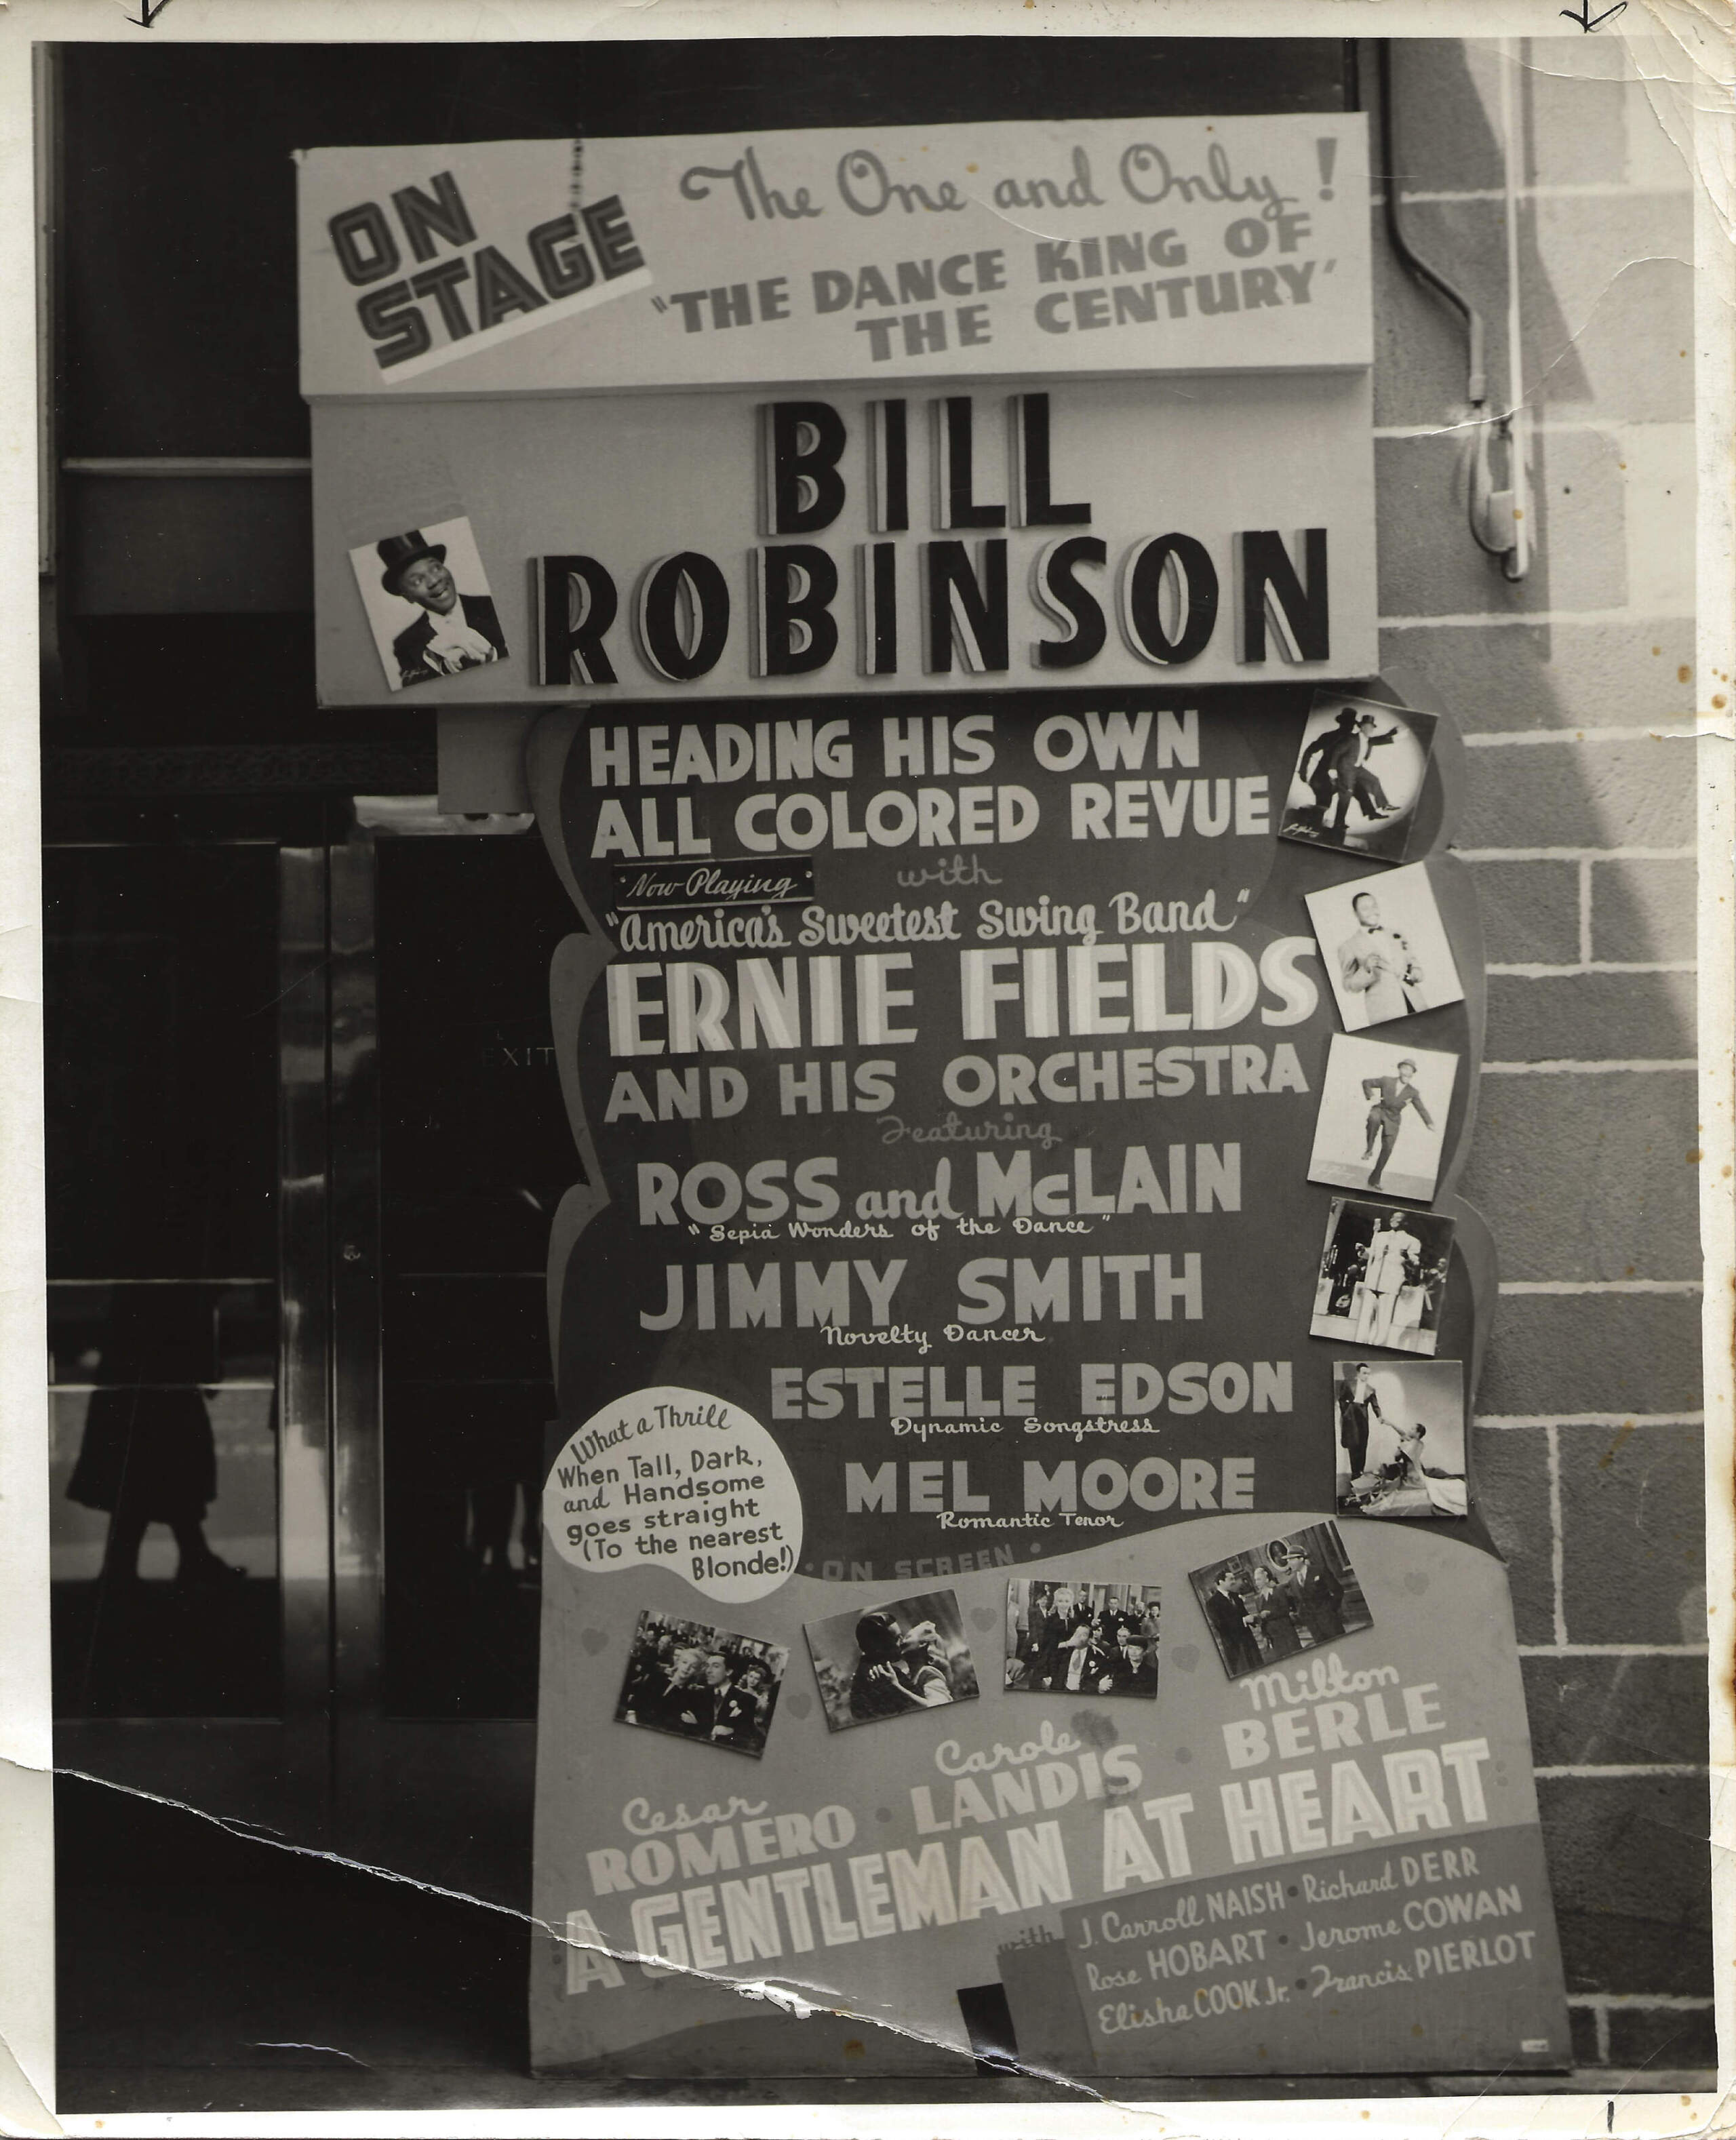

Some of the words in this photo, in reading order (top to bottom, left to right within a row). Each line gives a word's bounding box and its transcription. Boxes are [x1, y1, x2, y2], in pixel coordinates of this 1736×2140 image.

[679, 146, 824, 221] The
[837, 149, 967, 216] One
[993, 145, 1105, 207] and
[328, 170, 478, 286] ON
[356, 195, 645, 368] STAGE
[812, 250, 1006, 314] DANCE
[1035, 229, 1187, 283] KING
[1224, 213, 1311, 258] OF
[855, 304, 991, 362] THE
[758, 393, 1092, 535] BILL
[528, 528, 1330, 686] ROBINSON
[589, 719, 853, 787] HEADING
[883, 715, 995, 777] HIS
[1033, 710, 1200, 771] OWN
[590, 797, 711, 858] ALL
[734, 785, 1040, 852] COLORED
[1071, 776, 1269, 839] REVUE
[686, 867, 797, 900] Playing
[897, 854, 1002, 886] with
[798, 900, 962, 946] Sweetest
[977, 895, 1103, 945] Swing
[606, 952, 919, 1056] ERNIE
[960, 936, 1318, 1040] FIELDS
[604, 1067, 749, 1122] AND
[779, 1060, 896, 1115] HIS
[943, 1043, 1309, 1107] ORCHESTRA
[877, 1111, 1062, 1149] Featuring
[637, 1157, 840, 1225] ROSS
[855, 1157, 964, 1219] and
[977, 1143, 1241, 1218] McLAIN
[788, 1221, 893, 1240] Wonders
[911, 1220, 939, 1240] of
[956, 1218, 1001, 1235] the
[639, 1259, 908, 1330] JIMMY
[957, 1252, 1203, 1324] SMITH
[821, 1324, 932, 1353] Novelty
[943, 1324, 1045, 1342] Dancer
[771, 1366, 1035, 1419] ESTELLE
[1081, 1361, 1293, 1414] EDSON
[570, 1420, 634, 1464] What
[637, 1418, 654, 1435] a
[654, 1404, 731, 1429] Thrill
[890, 1416, 1004, 1442] Dynamic
[1024, 1416, 1160, 1442] Songstress
[557, 1464, 619, 1488] When
[628, 1453, 682, 1480] Tall,
[691, 1445, 762, 1472] Dark,
[564, 1486, 610, 1513] and
[624, 1475, 765, 1505] Handsome
[845, 1461, 989, 1513] MEL
[1023, 1457, 1255, 1512] MOORE
[567, 1519, 631, 1546] goes
[644, 1499, 760, 1529] straight
[583, 1539, 622, 1562] (To
[635, 1534, 677, 1555] the
[690, 1522, 783, 1551] nearest
[936, 1511, 1054, 1529] Romantic
[1059, 1513, 1124, 1527] Tenor
[692, 1545, 793, 1581] Blonde!)
[822, 1560, 873, 1582] ON
[894, 1543, 1015, 1580] SCREEN
[1240, 1652, 1400, 1711] Milton
[935, 1720, 1081, 1776] Carole
[1222, 1682, 1446, 1770] BERLE
[623, 1796, 769, 1836] Cesar
[910, 1745, 1143, 1835] LANDIS
[566, 1909, 625, 1996] A
[631, 1821, 1072, 1978] GENTLEMAN
[1103, 1792, 1194, 1893] AT
[1220, 1737, 1491, 1865] HEART
[586, 1805, 856, 1896] ROMERO
[1302, 1861, 1398, 1903] Richard
[1401, 1847, 1480, 1887] DERR
[1079, 1918, 1098, 1949] J.
[1101, 1895, 1204, 1943] Carroll
[1206, 1880, 1286, 1922] NAISH
[1300, 1920, 1401, 1951] Jerome
[1404, 1884, 1523, 1931] COWAN
[1086, 1962, 1142, 1992] Rose
[1147, 1930, 1267, 1980] HOBART
[1311, 1960, 1413, 1998] Francis
[1415, 1931, 1535, 1978] PIERLOT
[1099, 1998, 1193, 2035] Elisha
[1194, 1979, 1261, 2018] COOK
[1265, 1977, 1290, 2006] Jr.
